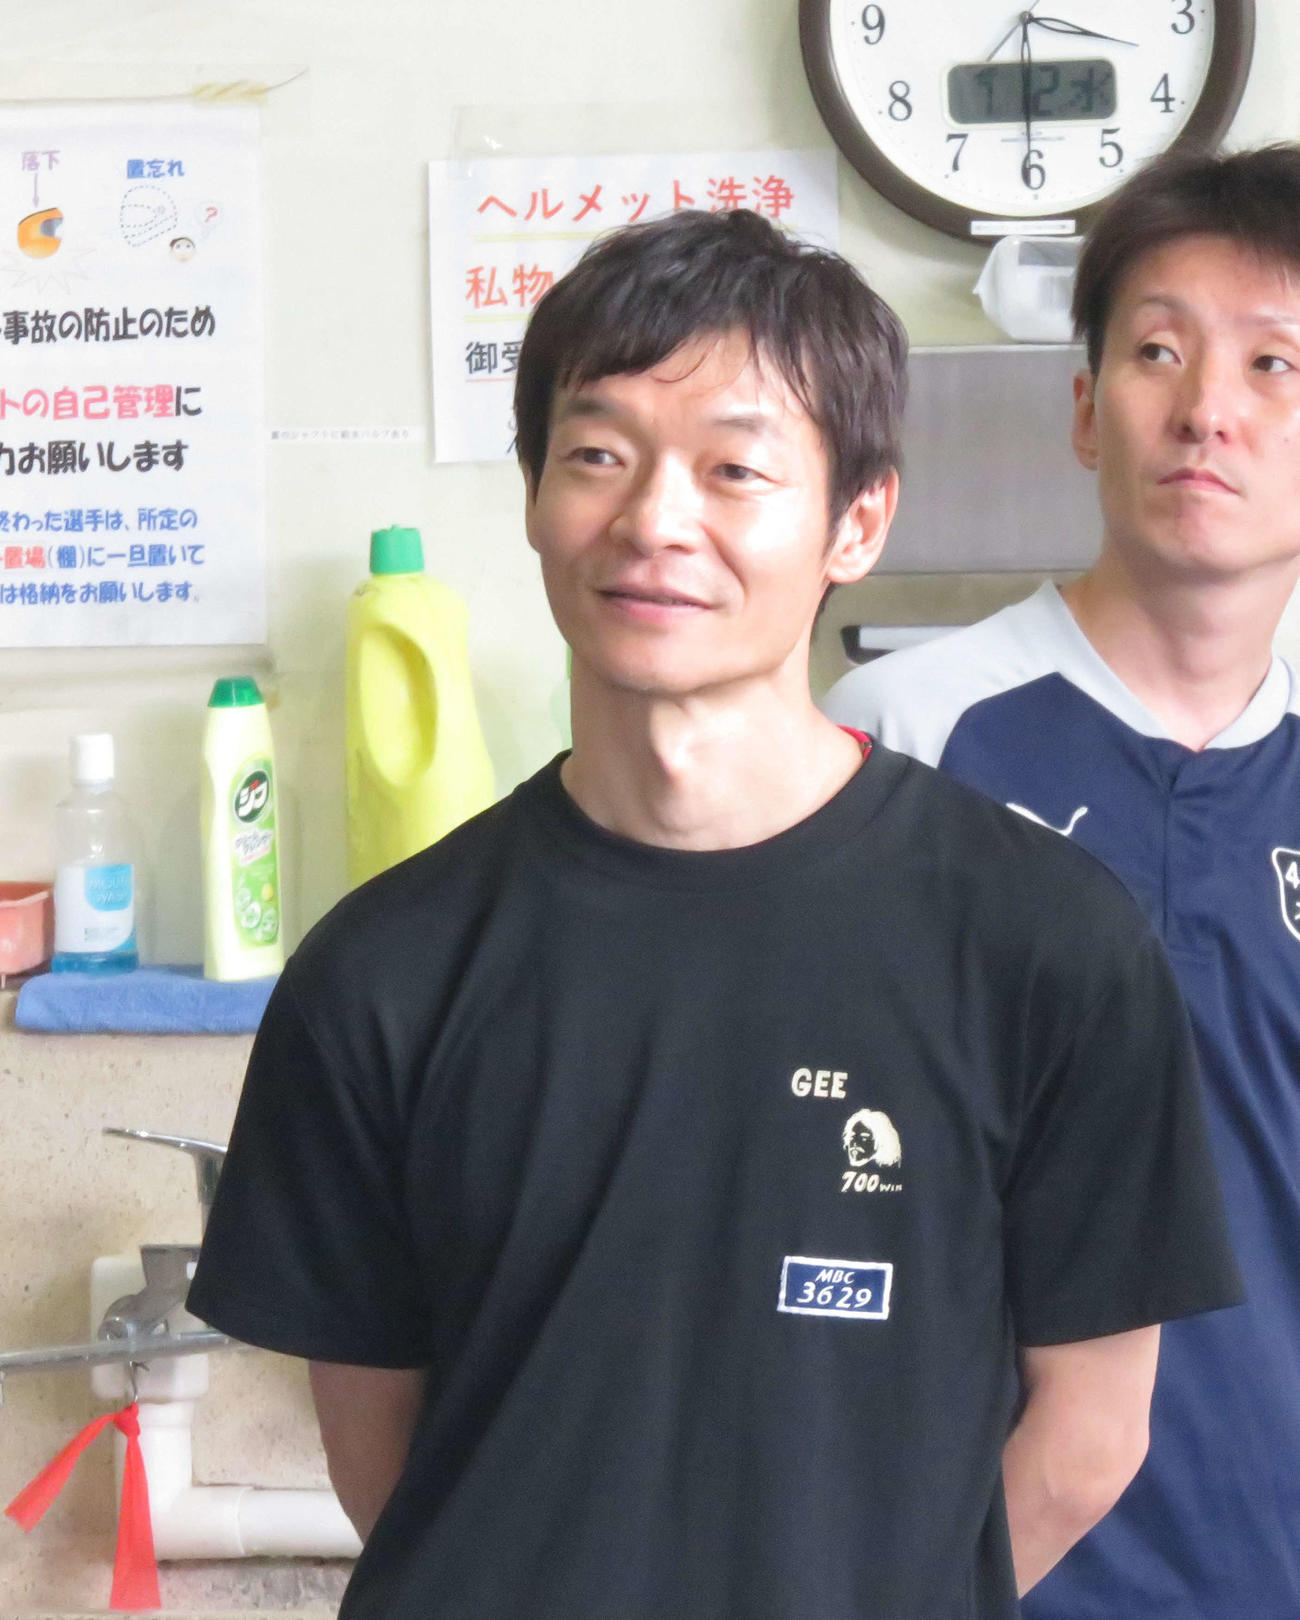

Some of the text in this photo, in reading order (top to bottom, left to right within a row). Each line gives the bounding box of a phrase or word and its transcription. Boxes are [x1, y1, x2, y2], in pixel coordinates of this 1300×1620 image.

[861, 4, 886, 45] 9
[1171, 0, 1195, 35] 3
[887, 80, 914, 121] 8
[1150, 73, 1176, 113] 4
[946, 133, 969, 172] 7
[1099, 128, 1124, 167] 5
[1021, 149, 1046, 190] 6
[476, 174, 795, 222] ヘルメット洗浄
[0, 305, 216, 345] 事故の防止のため
[791, 1067, 848, 1100] GEE
[840, 1170, 880, 1193] 700
[796, 1282, 873, 1309] 3629
[815, 1268, 855, 1284] MBC
